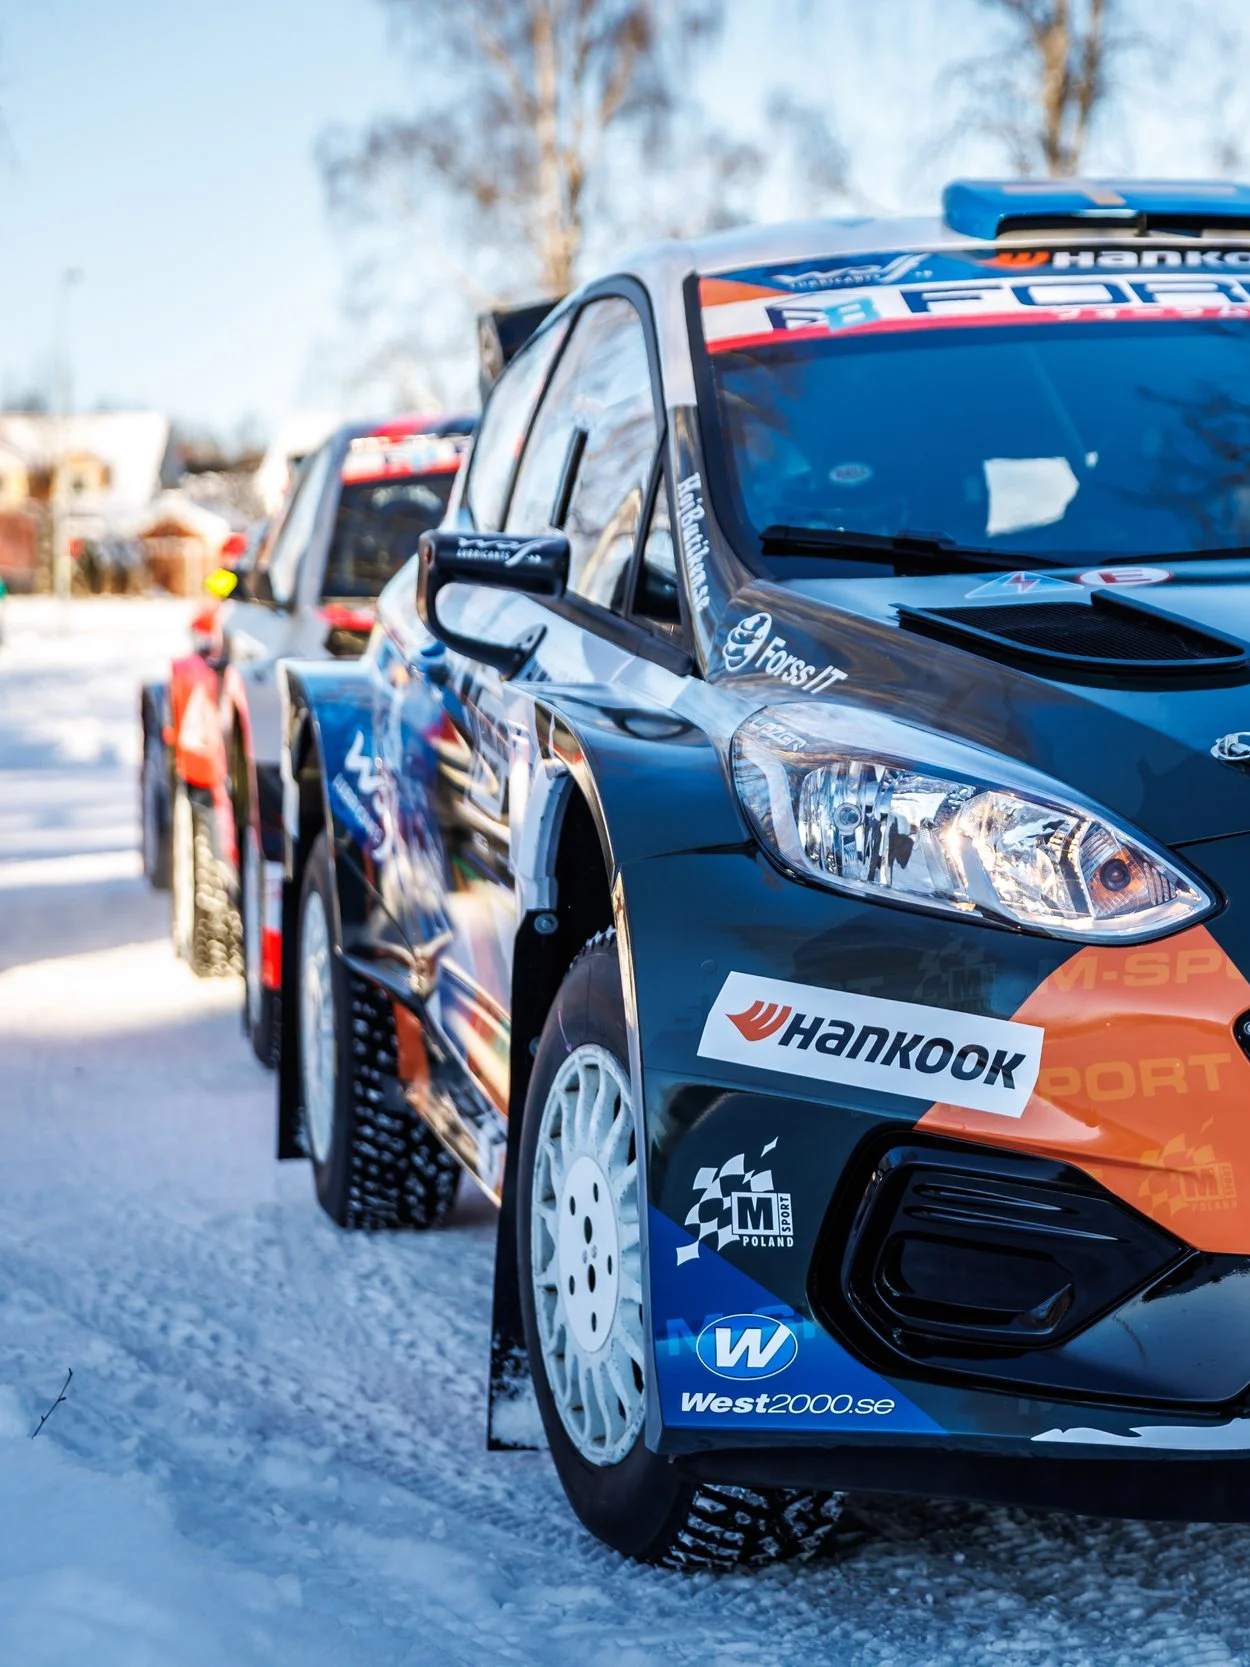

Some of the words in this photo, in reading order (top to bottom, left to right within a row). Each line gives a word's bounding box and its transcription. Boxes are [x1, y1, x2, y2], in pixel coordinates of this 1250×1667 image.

[755, 636, 816, 687] Forss
[802, 665, 848, 694] IT
[737, 1196, 774, 1231] M
[779, 1196, 792, 1233] SPORT
[743, 1236, 794, 1247] POLAND
[715, 1323, 792, 1368] W
[681, 1392, 896, 1415] West2000.se
